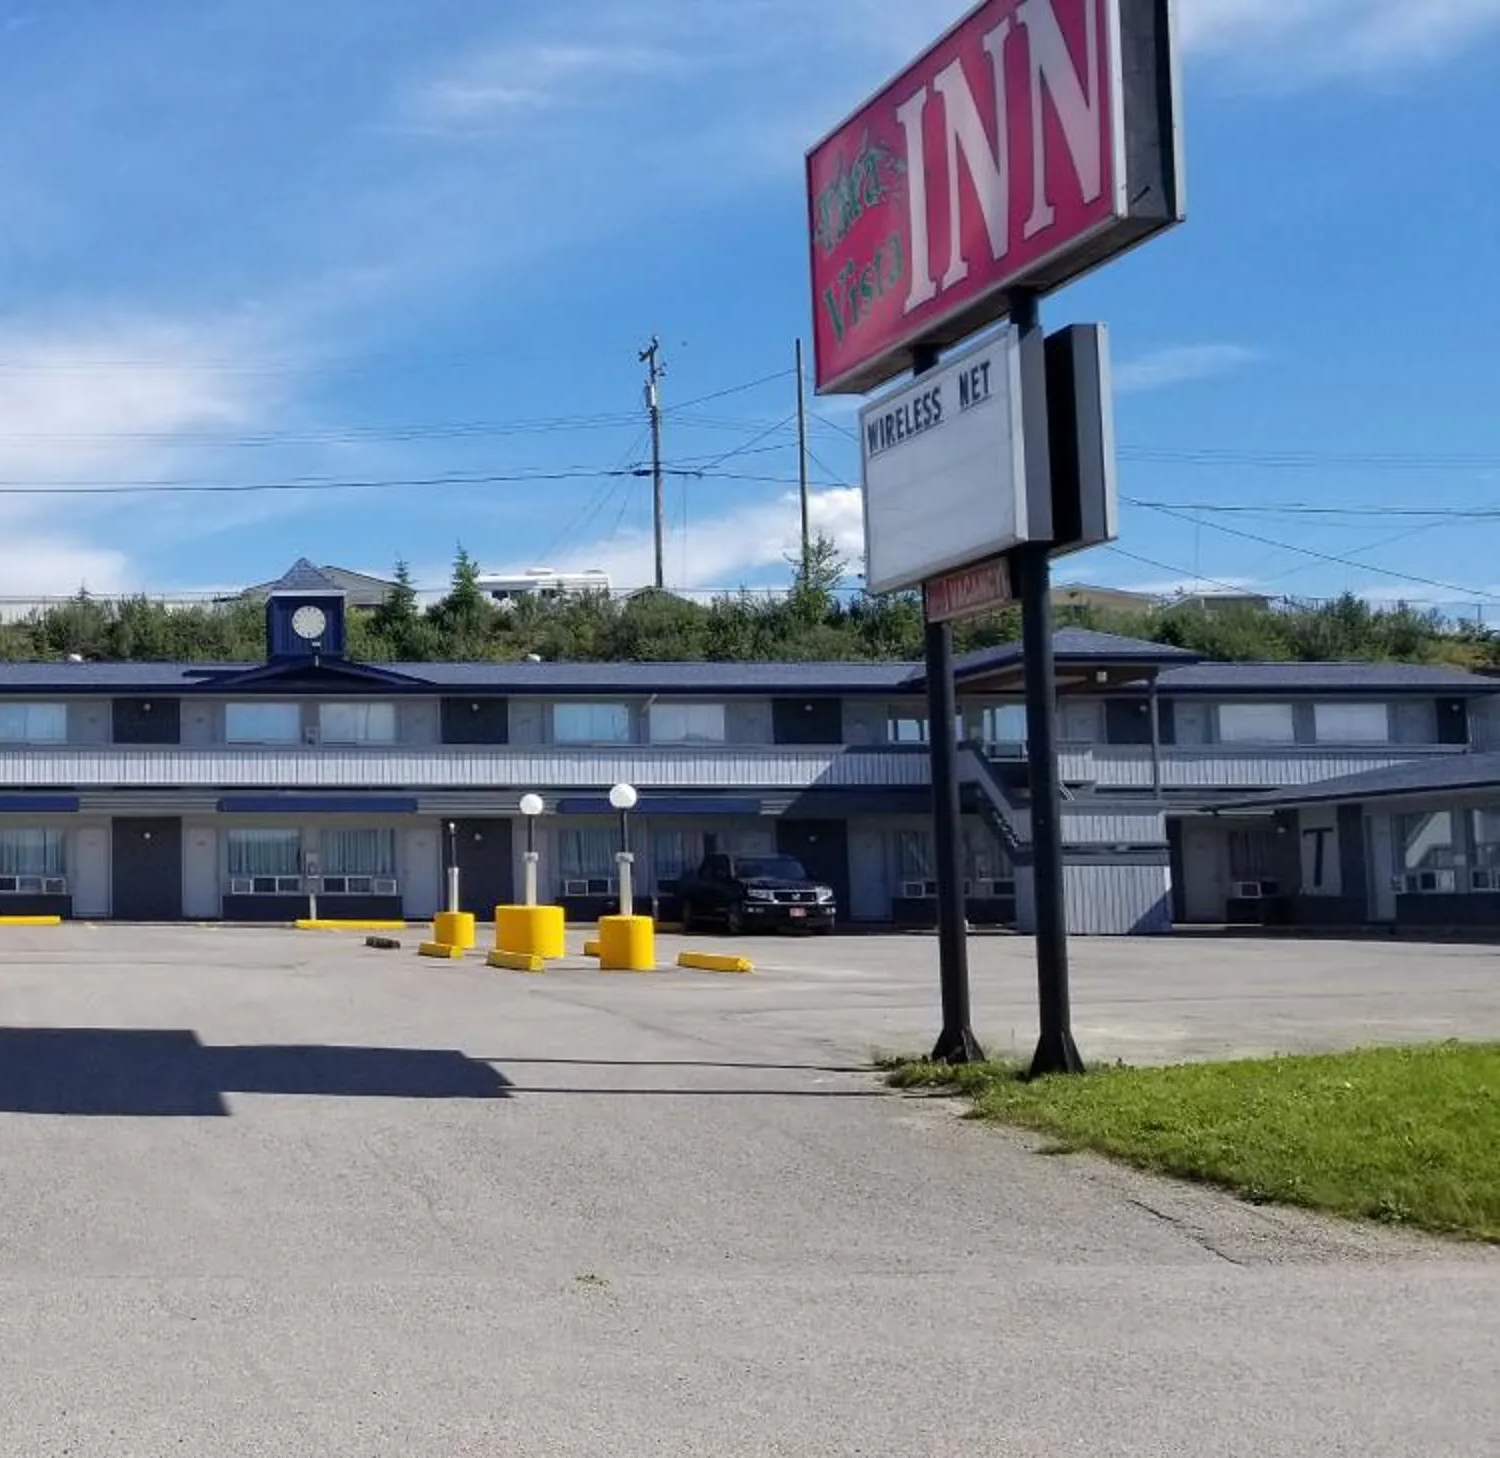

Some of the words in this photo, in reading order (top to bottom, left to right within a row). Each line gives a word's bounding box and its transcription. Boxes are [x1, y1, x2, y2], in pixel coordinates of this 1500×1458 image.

[896, 0, 1101, 316] INN
[824, 232, 903, 342] Vista
[867, 386, 942, 455] WIRELESS
[959, 359, 991, 408] NET
